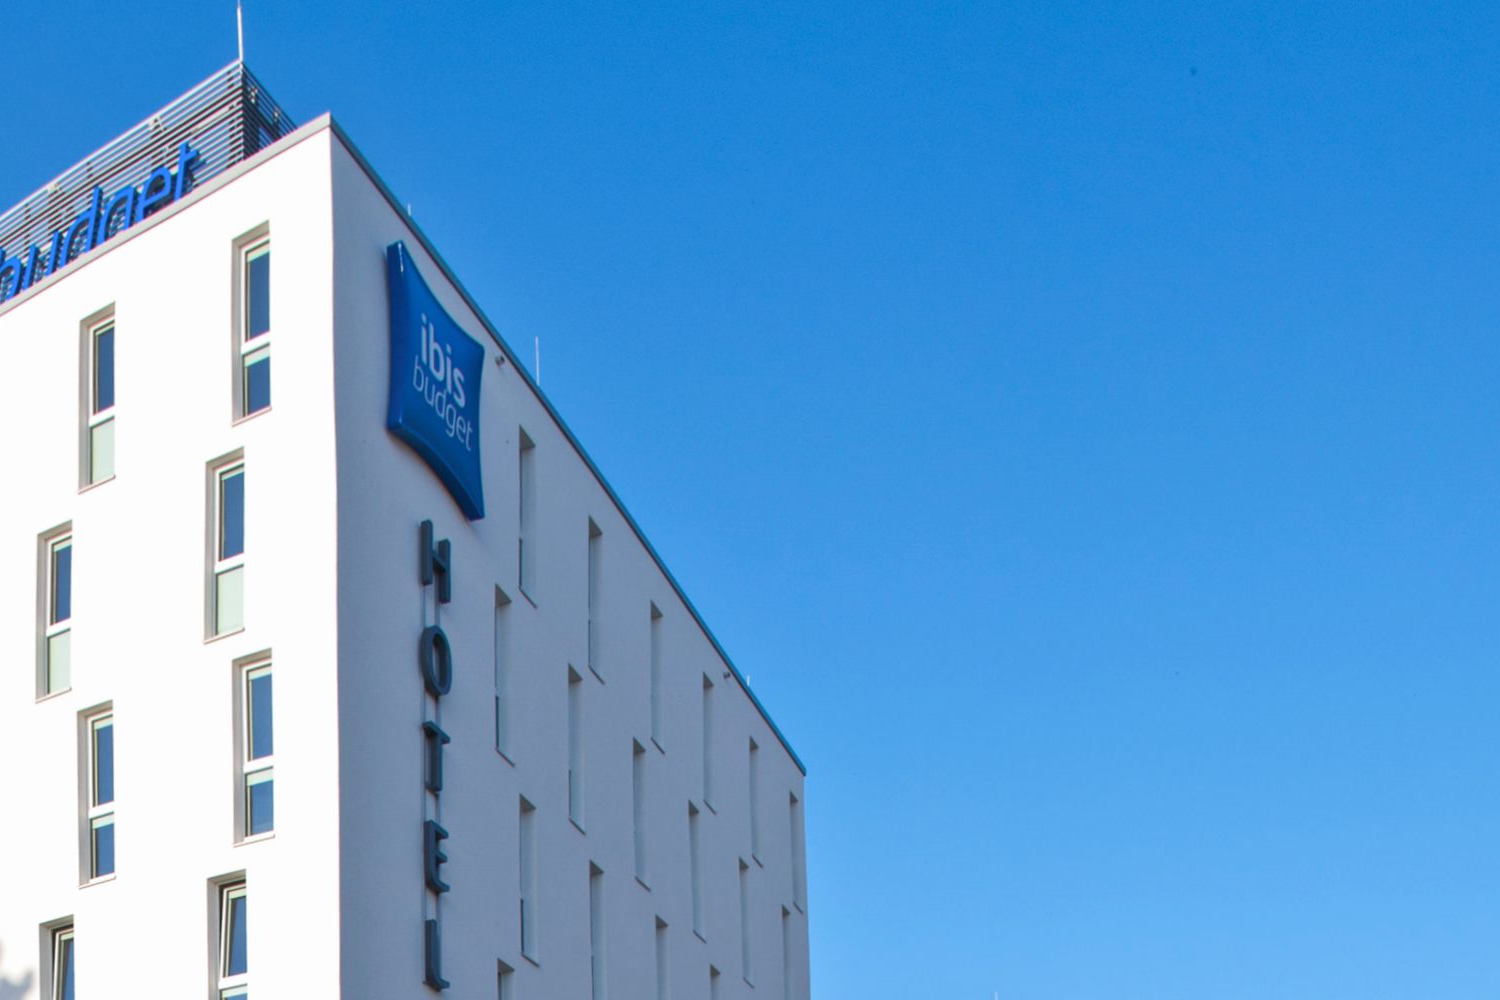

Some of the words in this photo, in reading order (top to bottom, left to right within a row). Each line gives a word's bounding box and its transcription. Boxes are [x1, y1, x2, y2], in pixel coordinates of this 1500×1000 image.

[412, 355, 474, 452] budget
[420, 312, 466, 409] ibis
[420, 519, 451, 992] HOTEL
